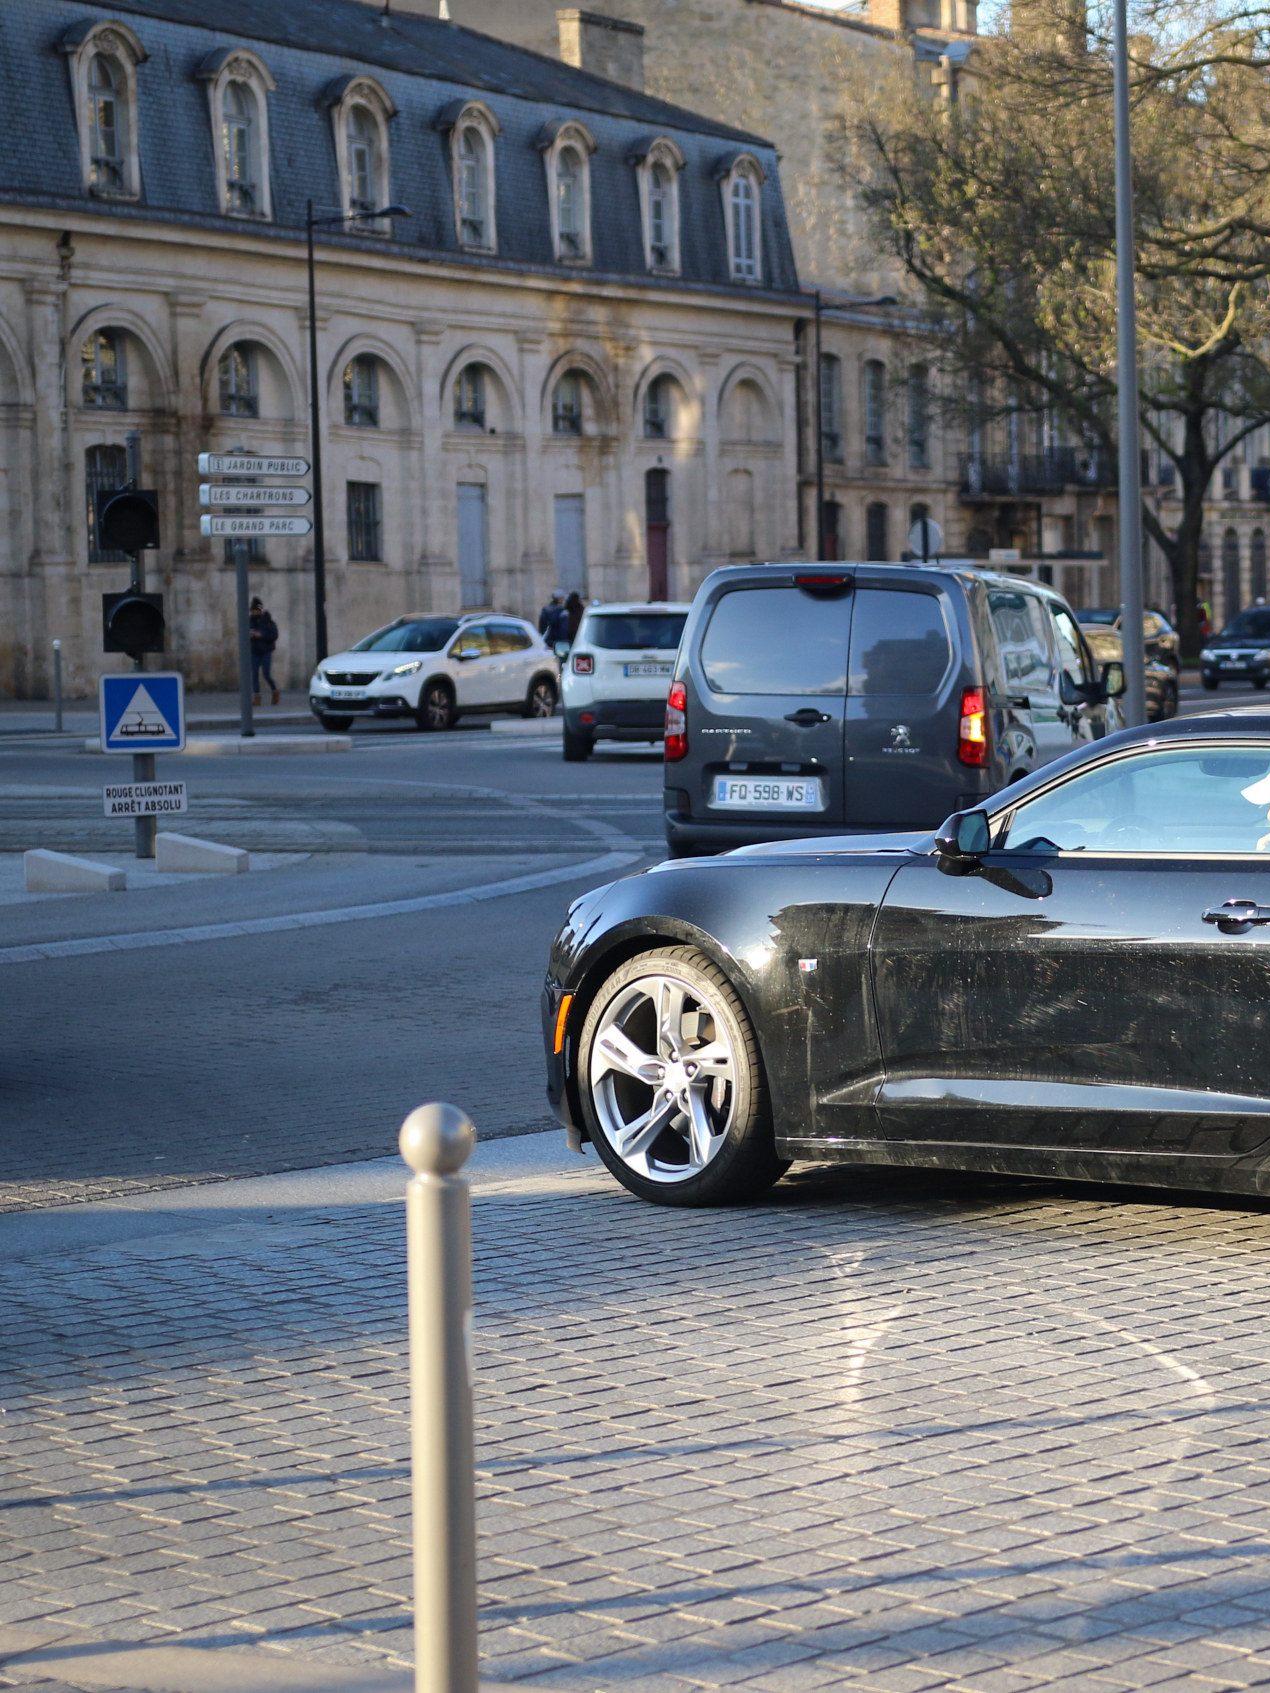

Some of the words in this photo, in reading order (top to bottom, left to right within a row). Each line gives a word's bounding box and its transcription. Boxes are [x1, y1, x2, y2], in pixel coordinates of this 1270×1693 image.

[227, 459, 263, 471] JARDIN
[267, 460, 301, 472] PUBLIC
[214, 490, 230, 500] LES
[235, 490, 294, 501] CHARTRONS
[215, 521, 227, 531] LE
[231, 520, 264, 531] GRAND
[269, 520, 294, 531] PARC
[106, 786, 133, 799] ROUGE
[134, 783, 183, 797] CLIGNOTANT
[730, 784, 804, 802] FQ-598-WS
[111, 799, 142, 813] ARRÊT
[144, 799, 181, 812] ABSOLU
